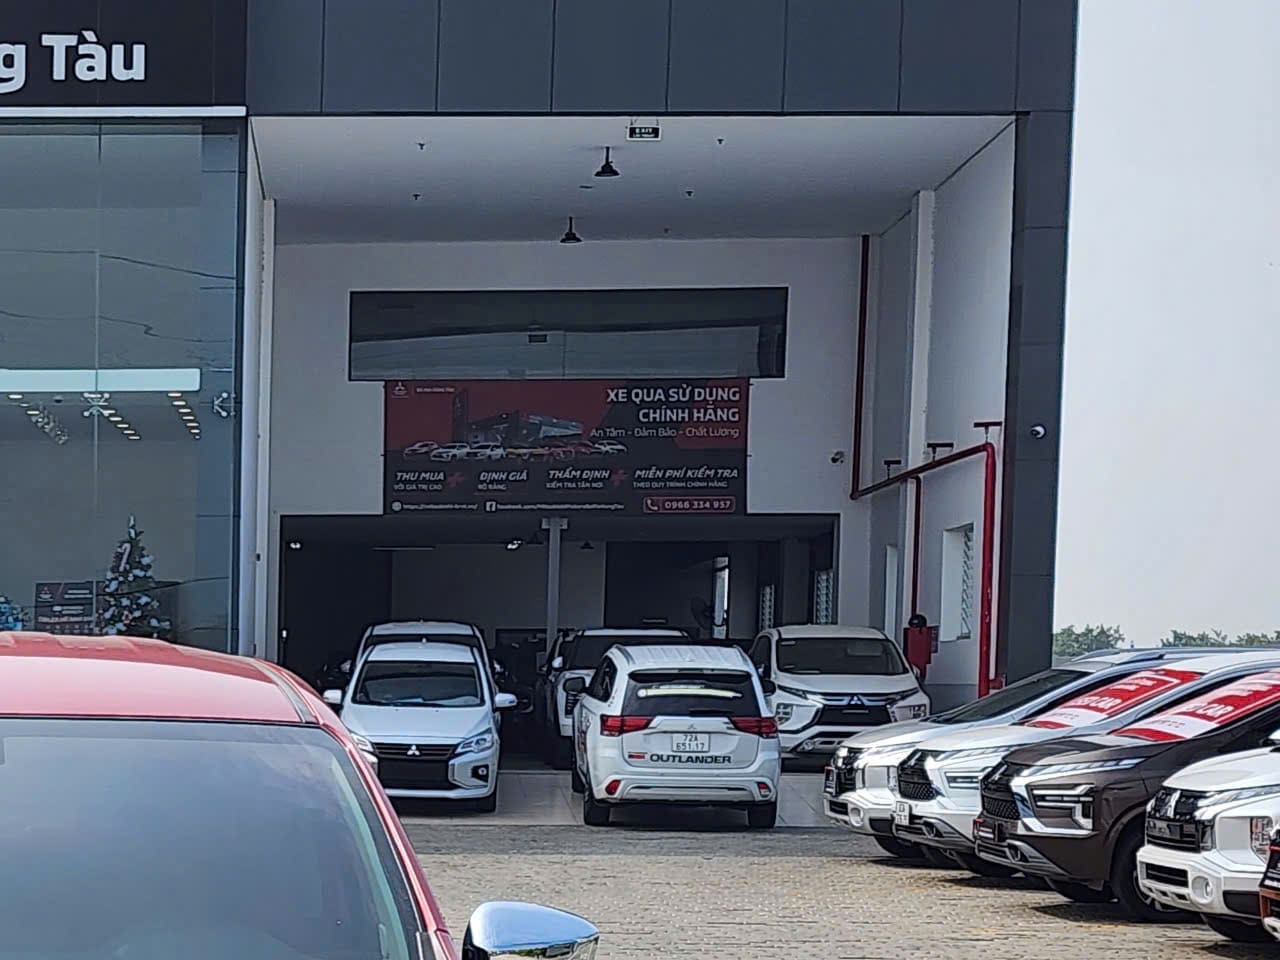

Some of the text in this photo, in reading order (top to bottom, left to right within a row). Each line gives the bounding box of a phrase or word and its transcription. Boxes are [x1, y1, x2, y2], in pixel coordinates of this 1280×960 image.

[41, 30, 146, 81] Tàu
[607, 384, 740, 404] XE QUA SỬ DỤNG
[639, 405, 740, 422] CHÍNH HÃNG
[590, 428, 604, 437] An
[396, 471, 445, 481] THU MUA
[716, 468, 738, 478] TRA
[683, 734, 699, 742] 72A
[650, 753, 732, 764] OUTLANDER
